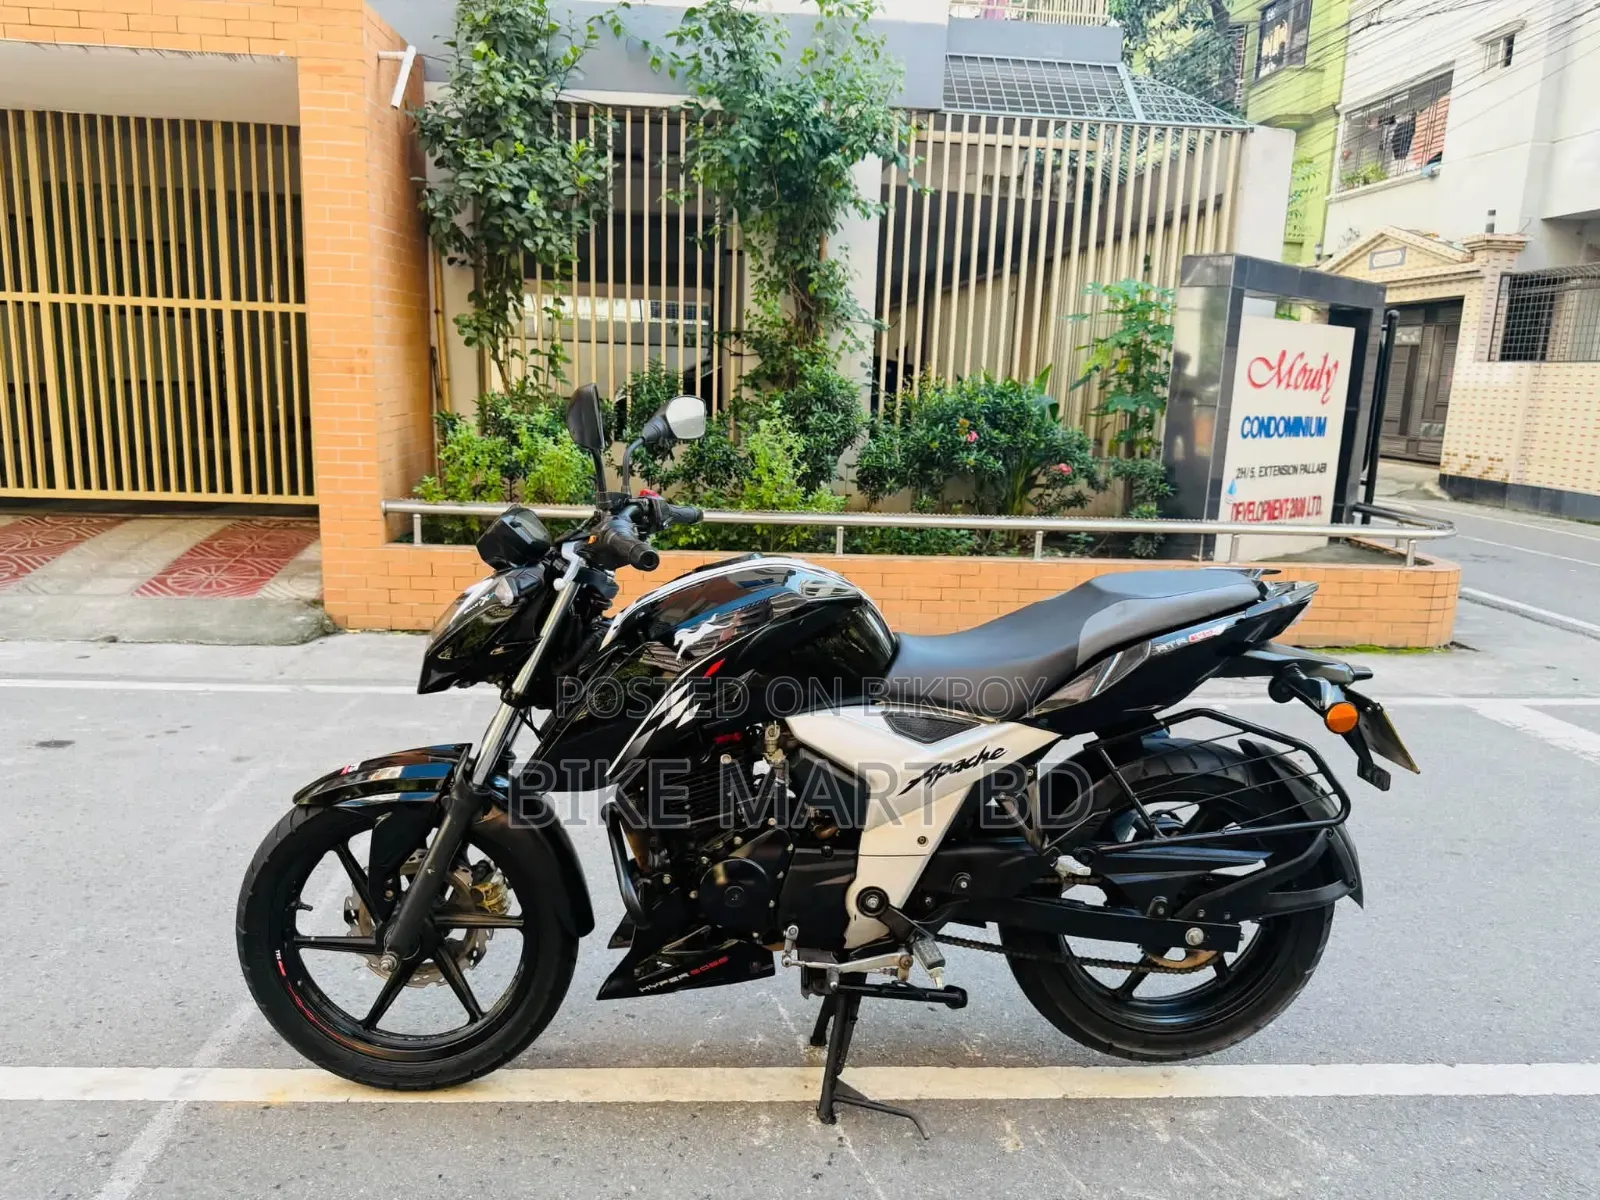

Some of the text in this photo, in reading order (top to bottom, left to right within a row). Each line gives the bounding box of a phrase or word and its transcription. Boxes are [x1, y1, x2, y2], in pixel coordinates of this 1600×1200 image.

[1247, 350, 1340, 405] Mouly
[1241, 416, 1327, 440] CONDOMINIUM
[897, 745, 1010, 797] Apache
